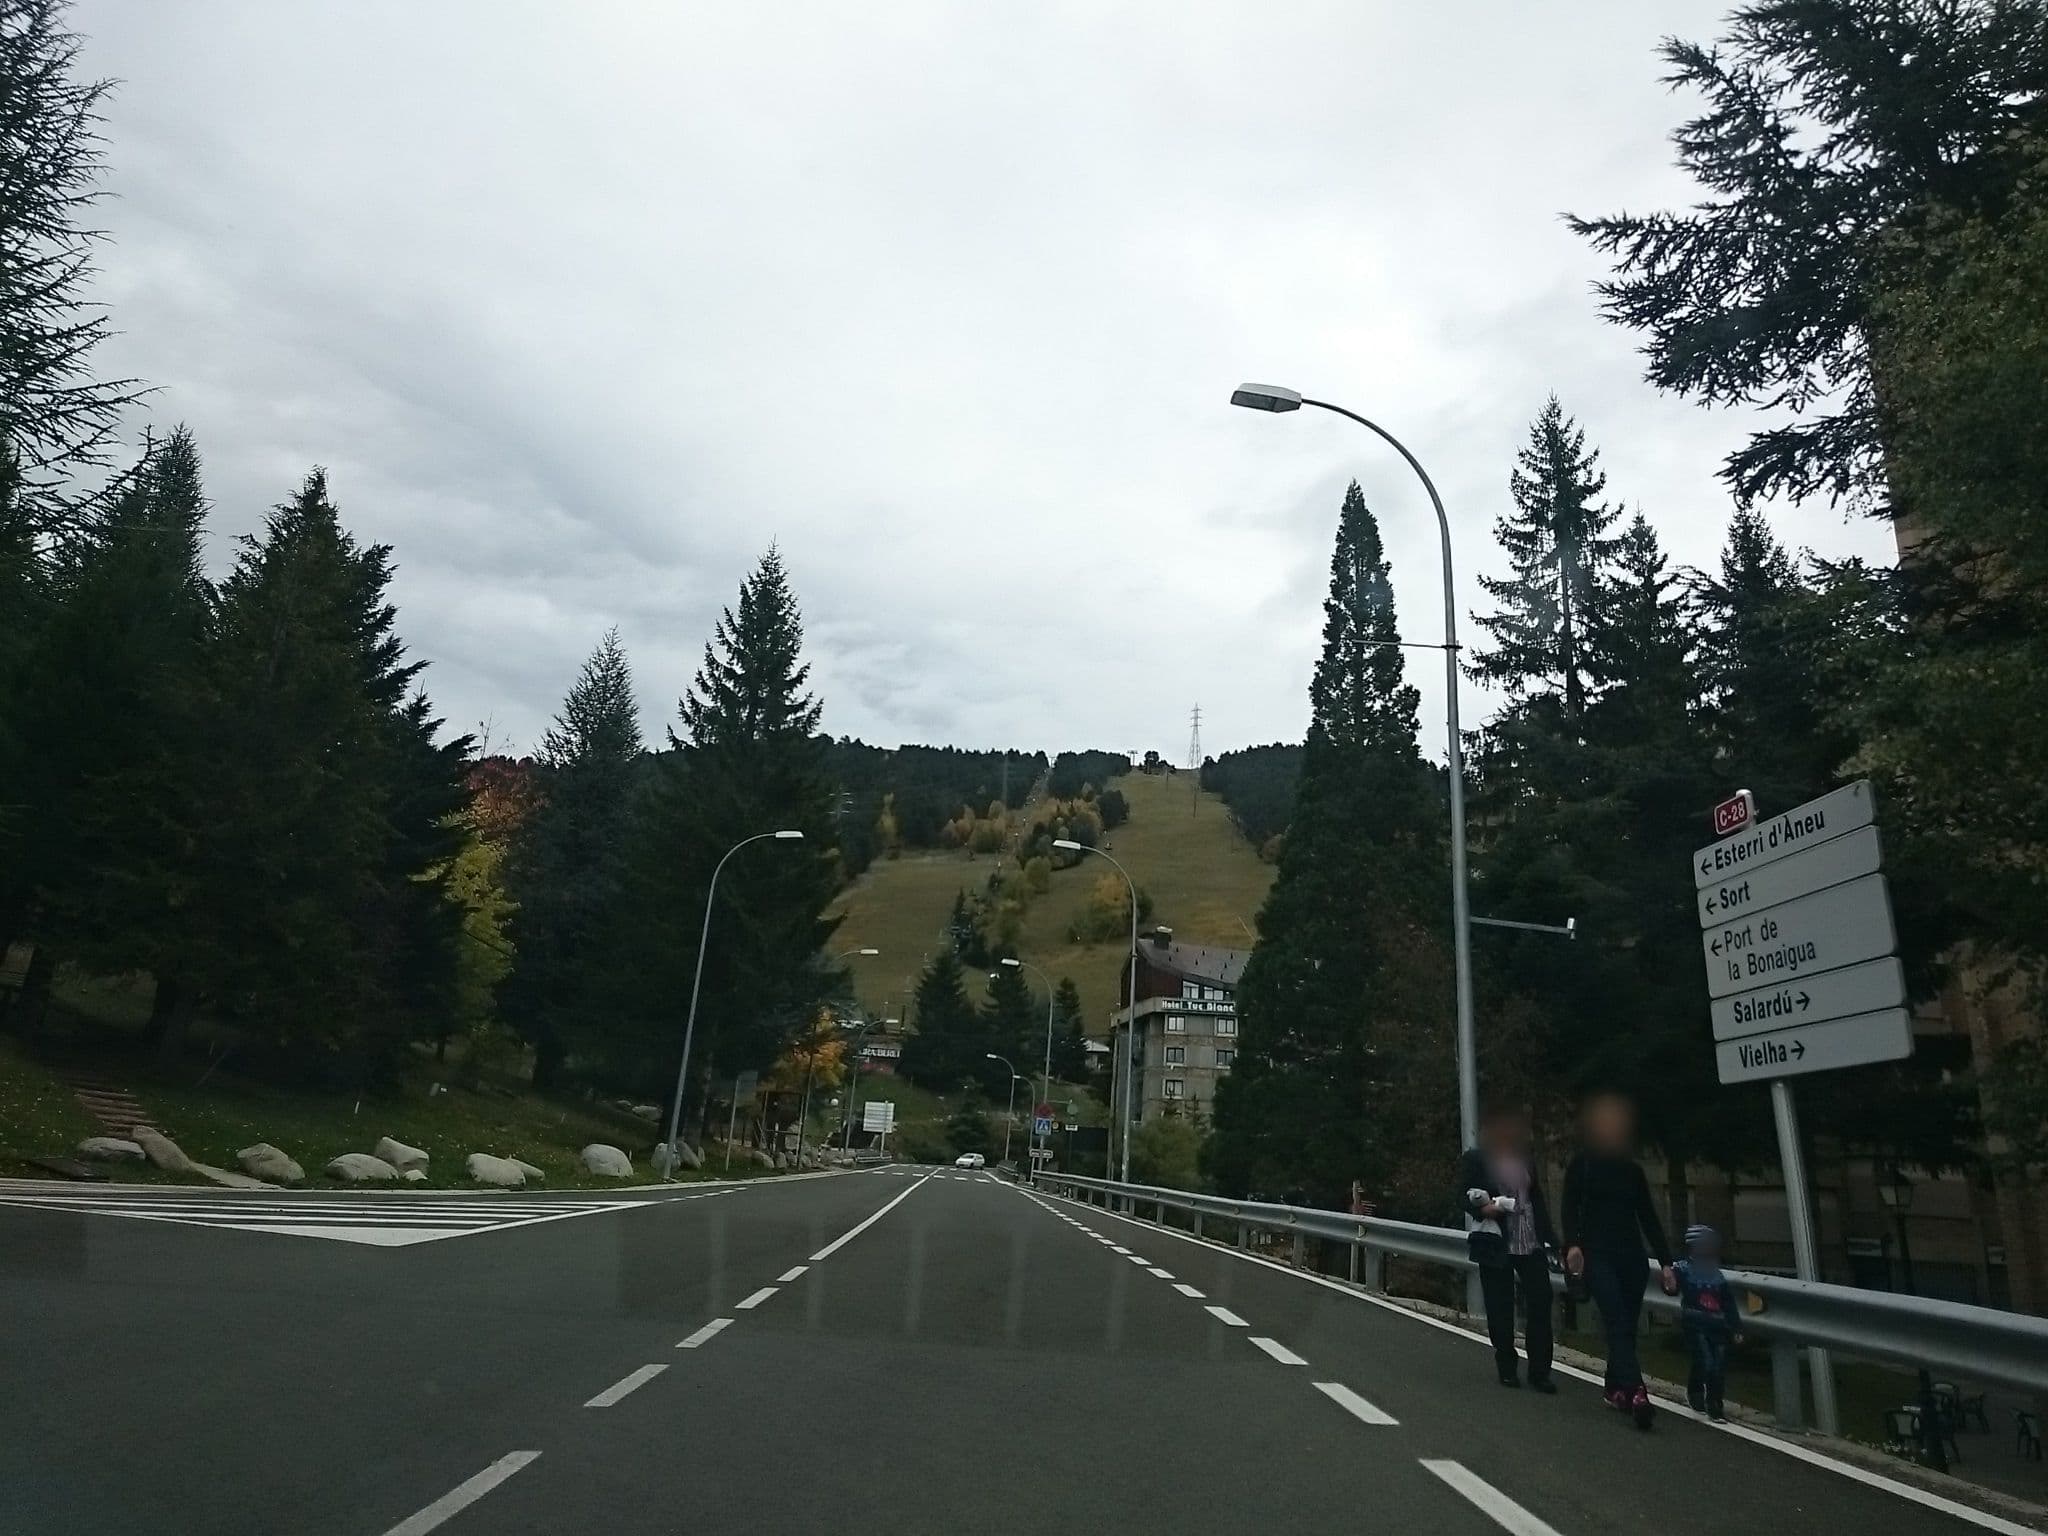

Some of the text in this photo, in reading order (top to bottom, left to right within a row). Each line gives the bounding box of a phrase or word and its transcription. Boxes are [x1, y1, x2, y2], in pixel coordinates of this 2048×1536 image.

[1718, 803, 1746, 828] C-28
[1714, 809, 1826, 872] Esterri d'Àneu
[1720, 883, 1751, 910] Sort
[1724, 918, 1779, 954] Port de
[1728, 941, 1817, 982] la Bonaigua
[1733, 989, 1793, 1024] Salardú
[1739, 1040, 1788, 1070] Vielha
